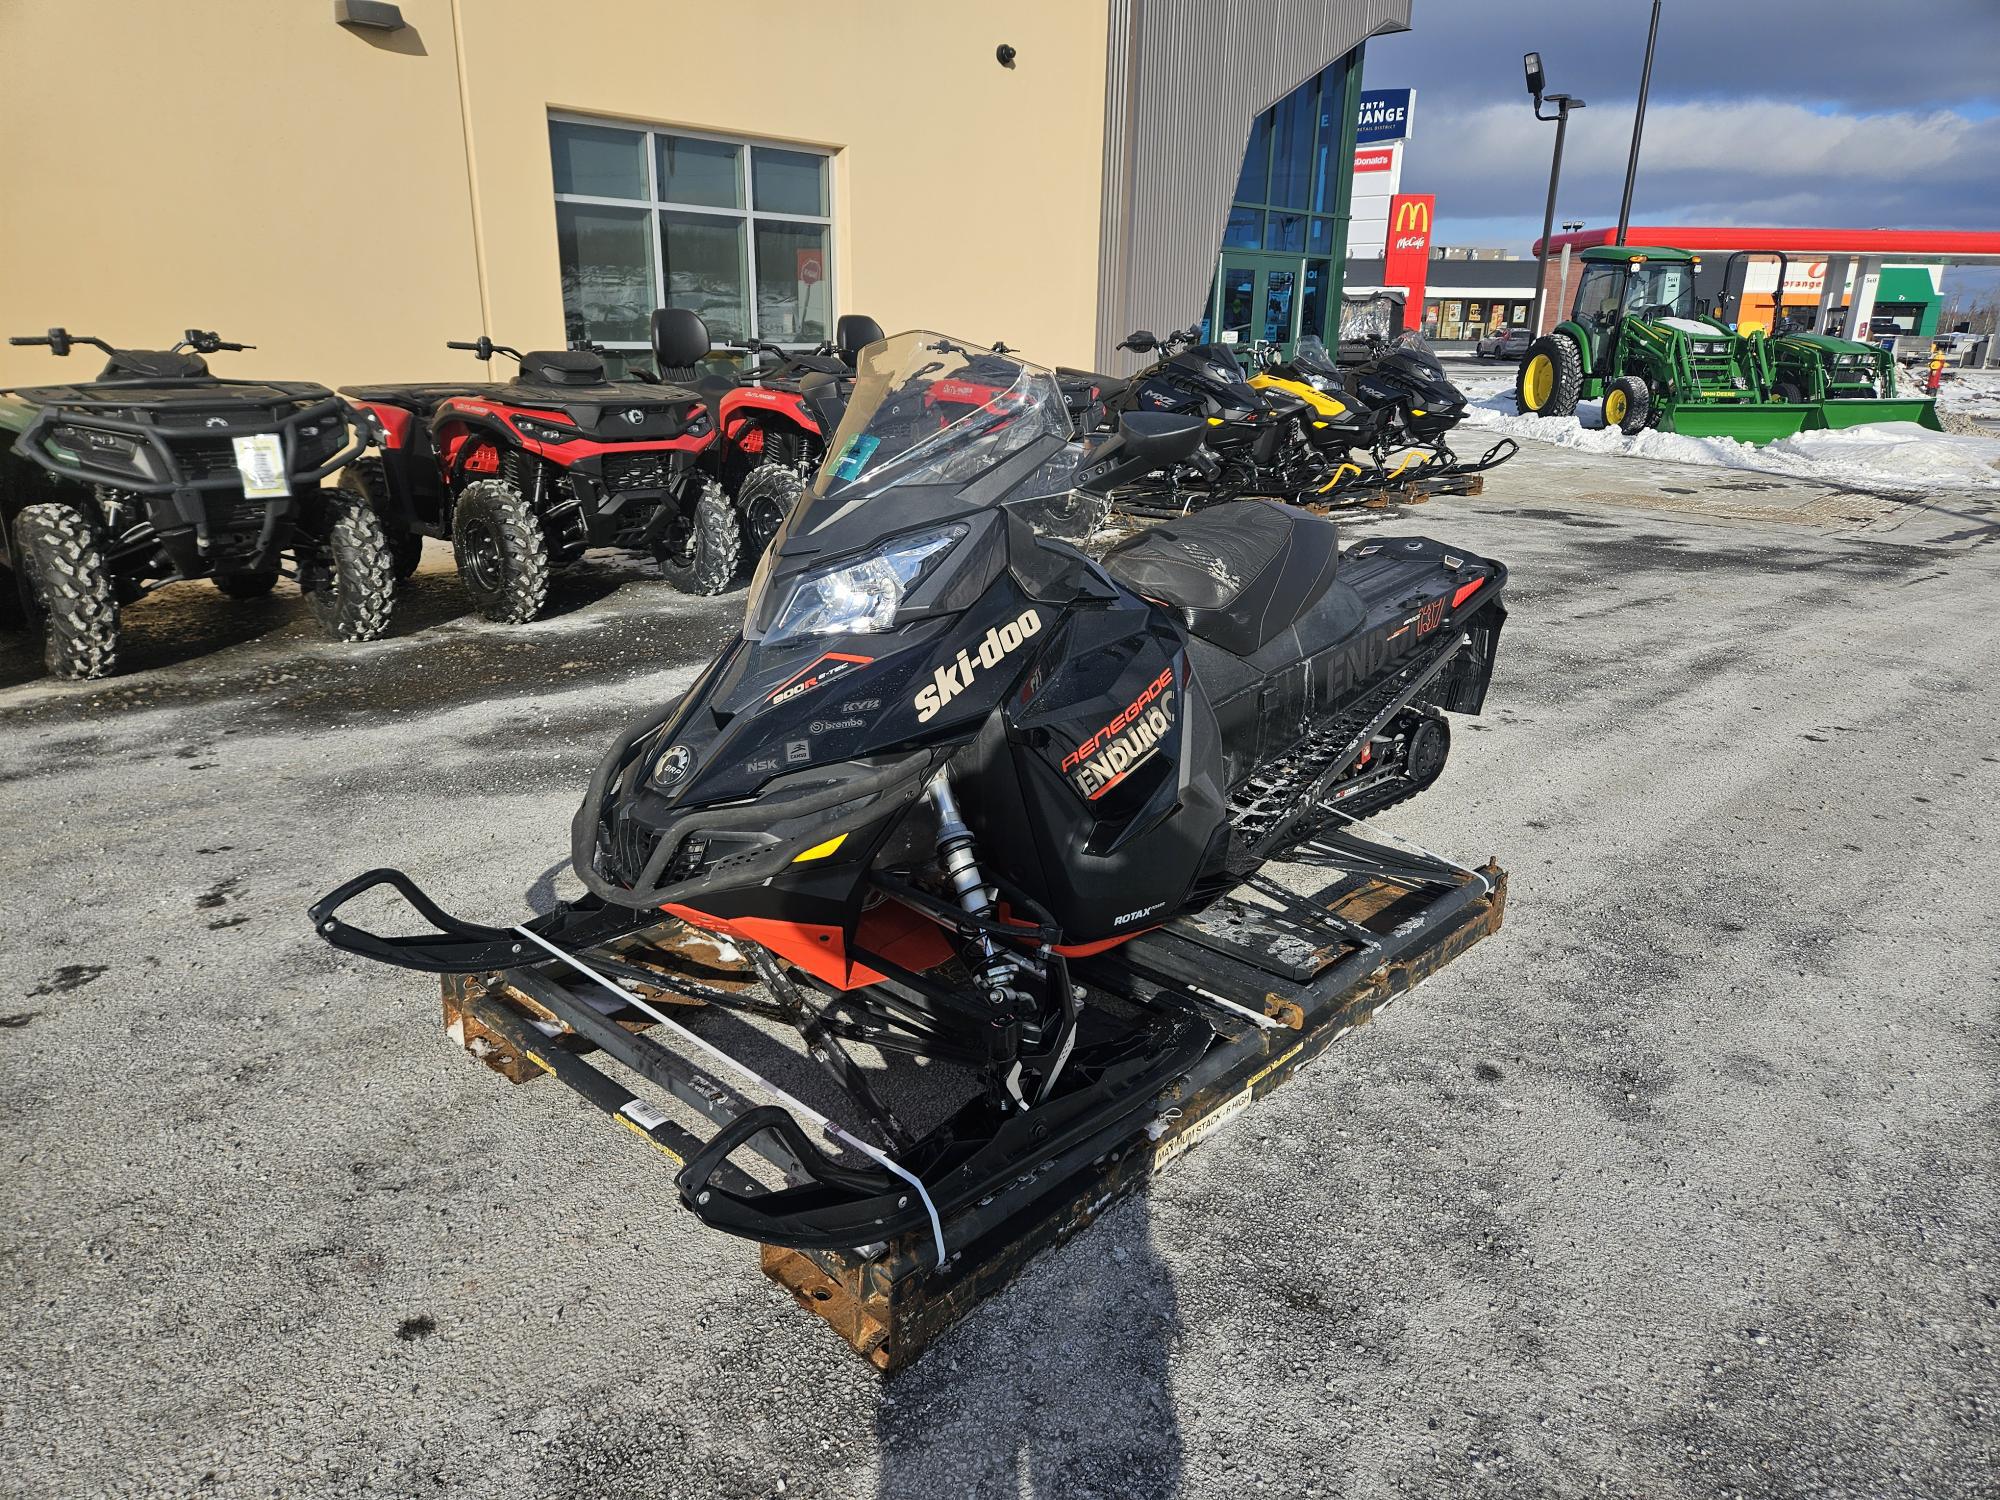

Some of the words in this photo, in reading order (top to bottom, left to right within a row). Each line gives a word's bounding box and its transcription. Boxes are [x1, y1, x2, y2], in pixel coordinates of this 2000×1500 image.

[1783, 279, 1822, 290] orange
[825, 719, 863, 730] brembo
[1061, 667, 1173, 773] RENEGADE
[1073, 700, 1173, 798] ENDURO
[664, 764, 682, 774] BRP
[748, 759, 778, 772] NSK
[1113, 906, 1151, 926] ROTAX
[1196, 1111, 1221, 1133] STACK
[1231, 1092, 1250, 1110] HIGH
